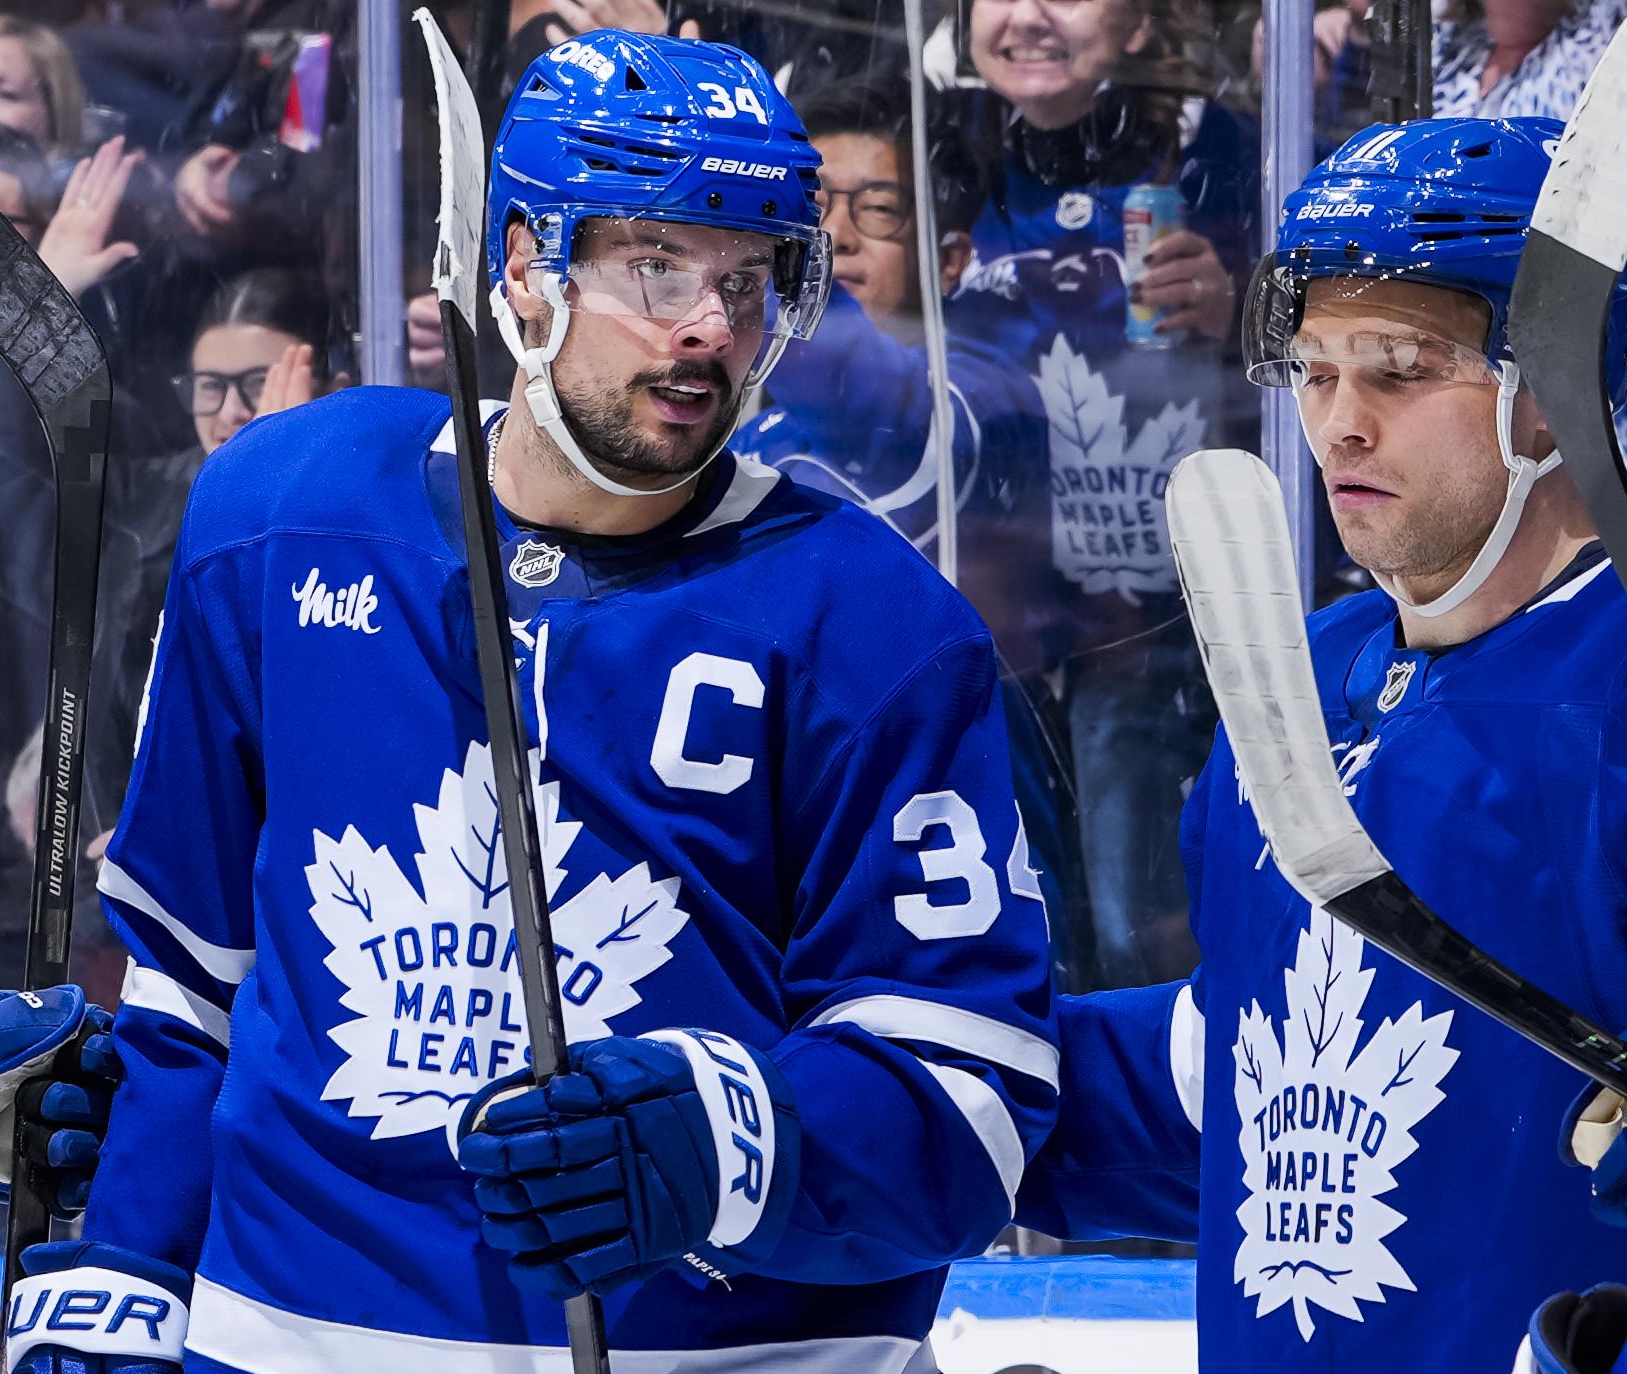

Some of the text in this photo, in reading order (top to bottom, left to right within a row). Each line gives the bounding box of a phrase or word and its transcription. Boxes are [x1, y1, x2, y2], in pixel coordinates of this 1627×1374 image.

[549, 41, 616, 81] OREO
[697, 82, 770, 126] 34
[701, 157, 788, 181] BAUER
[1296, 203, 1375, 221] BAUER
[1050, 465, 1171, 500] ORONTO
[1058, 500, 1156, 528] MAPLE
[517, 554, 556, 577] NHL
[1066, 530, 1161, 558] LEAFS
[292, 567, 382, 635] Milk
[56, 688, 76, 790] KICKPOINT
[648, 651, 766, 794] C
[48, 792, 69, 897] ULTRALOW
[394, 979, 521, 1033] MAPL
[386, 1028, 533, 1079] LEAF
[682, 1028, 763, 1205] UER
[1253, 1083, 1387, 1158] TORONTO
[1265, 1150, 1358, 1193] MAPLE
[1265, 1201, 1354, 1245] LEAFS
[6, 1289, 170, 1343] UER
